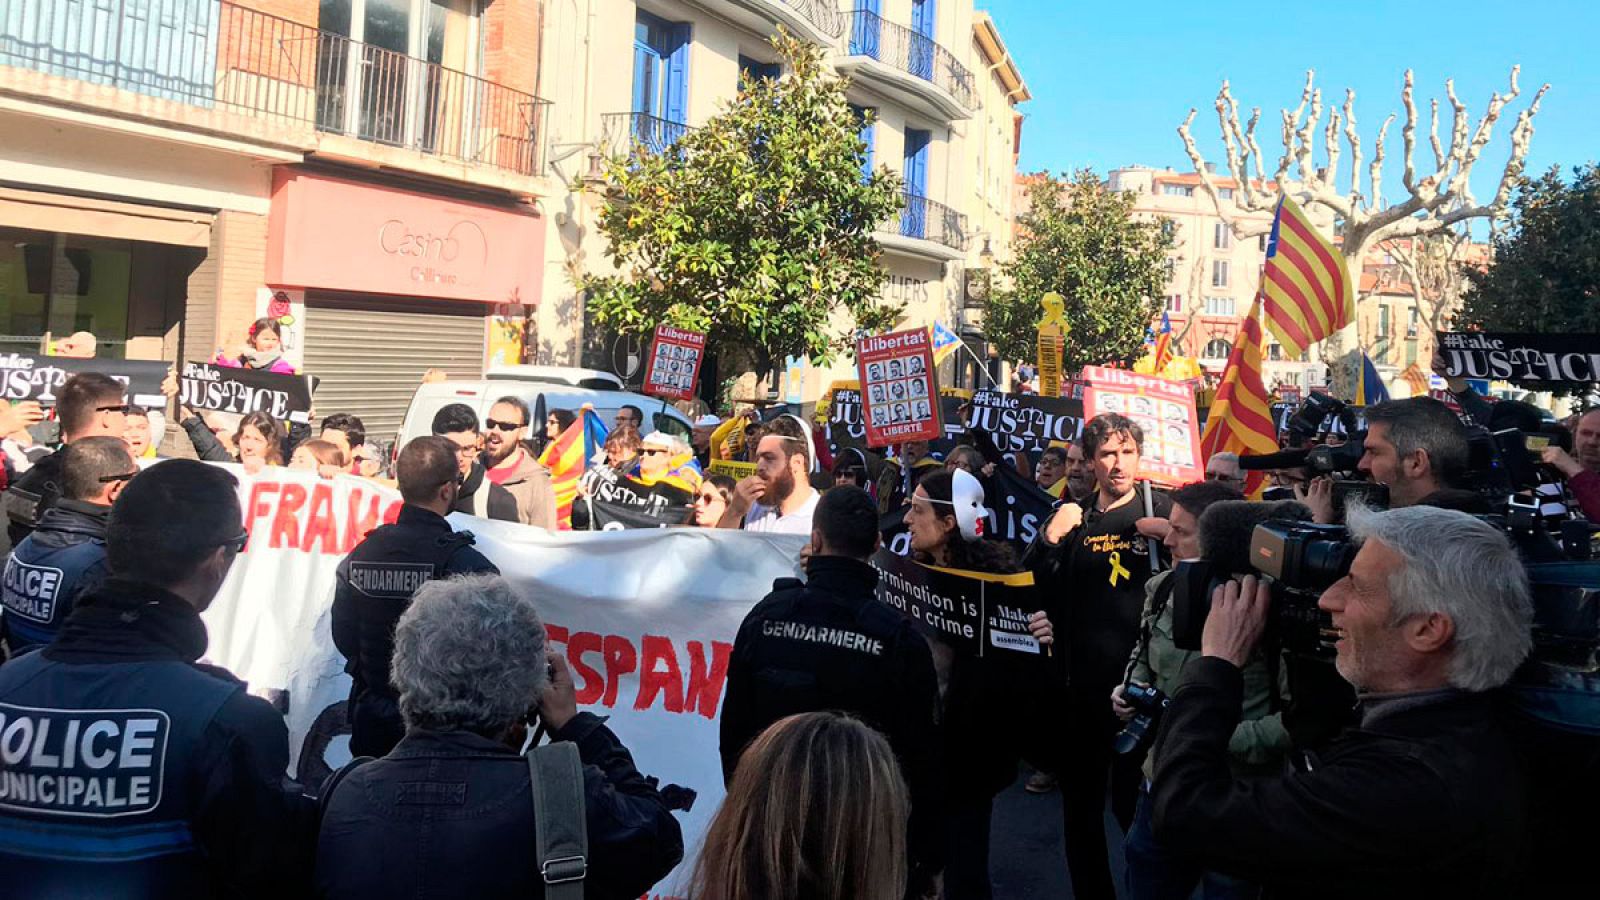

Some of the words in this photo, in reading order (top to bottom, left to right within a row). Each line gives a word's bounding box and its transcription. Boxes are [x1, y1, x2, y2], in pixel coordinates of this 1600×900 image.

[657, 326, 704, 344] Llibertat
[860, 331, 925, 353] Llibertat
[1444, 333, 1505, 350] #Fake
[179, 378, 289, 420] JUSTICE
[973, 391, 1020, 409] #Fake
[885, 590, 907, 612] not
[911, 604, 921, 620] a
[925, 611, 974, 639] crime
[960, 596, 978, 617] is
[762, 619, 884, 656] GENDARMERIE
